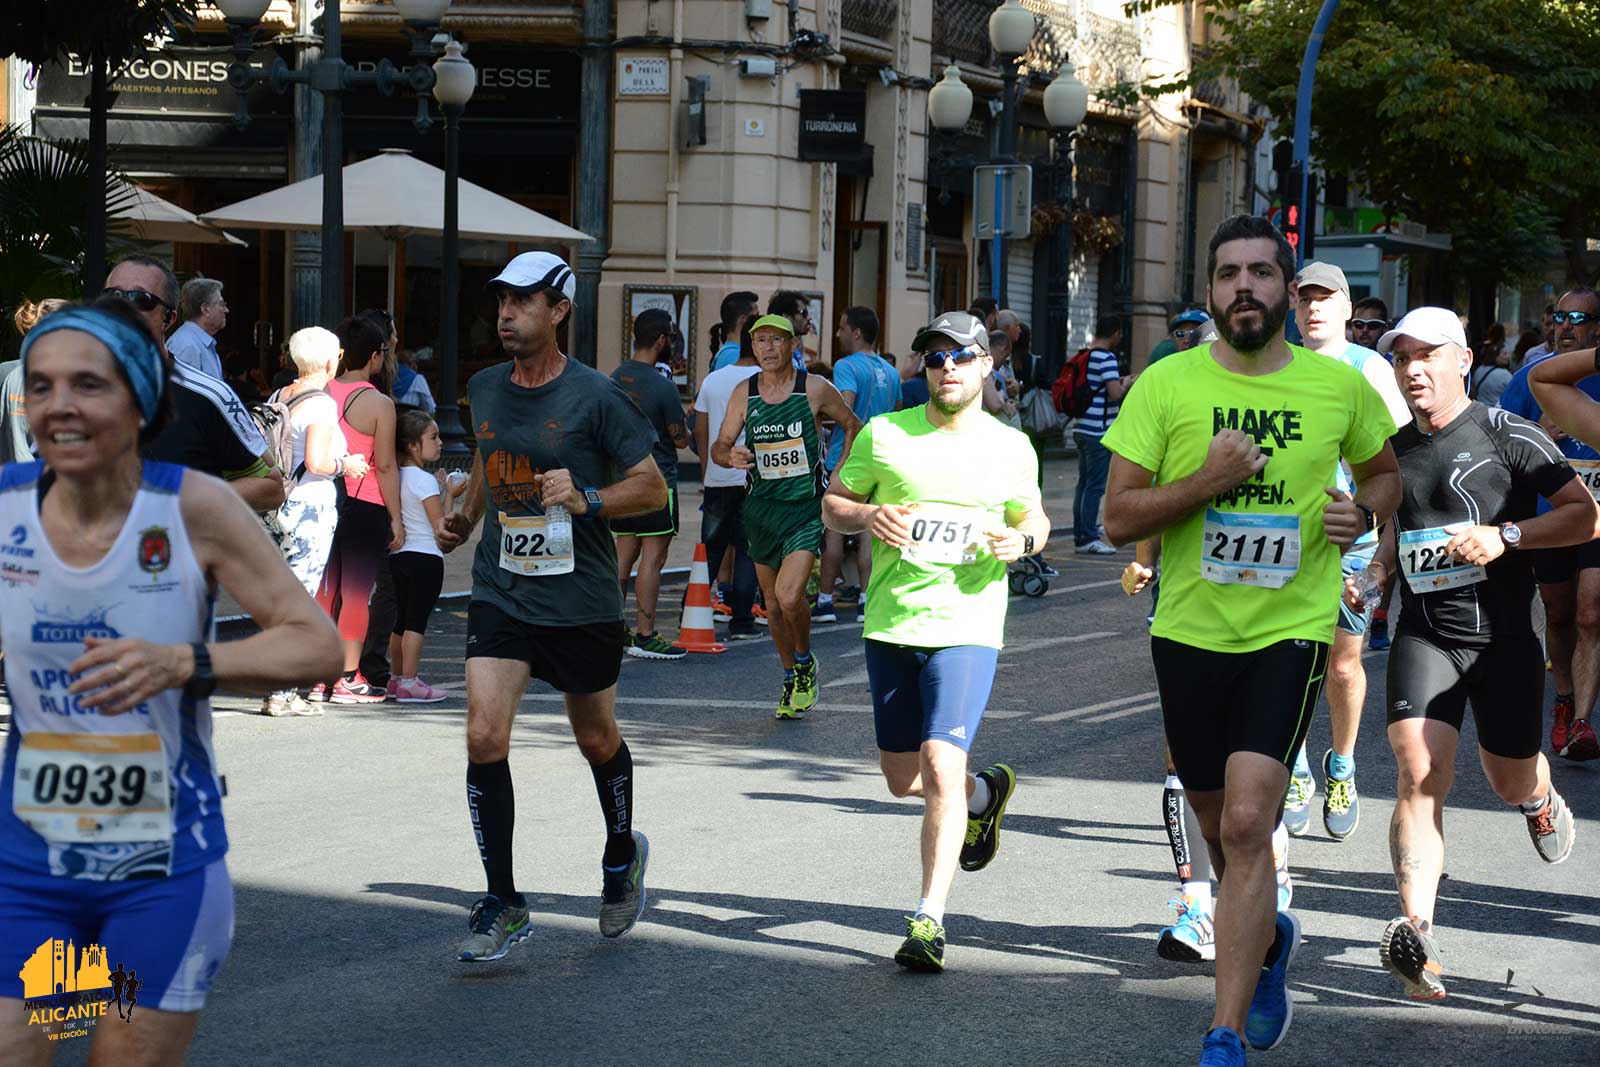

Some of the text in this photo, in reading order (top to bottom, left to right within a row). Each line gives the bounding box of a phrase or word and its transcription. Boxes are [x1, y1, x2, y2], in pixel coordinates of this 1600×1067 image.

[753, 424, 785, 434] urban
[1213, 406, 1303, 449] MAKE
[763, 450, 799, 468] 0558
[504, 533, 556, 557] 022
[911, 518, 973, 545] 0751
[1210, 531, 1286, 564] 2111
[1408, 545, 1467, 574] 122
[33, 762, 147, 807] 0939
